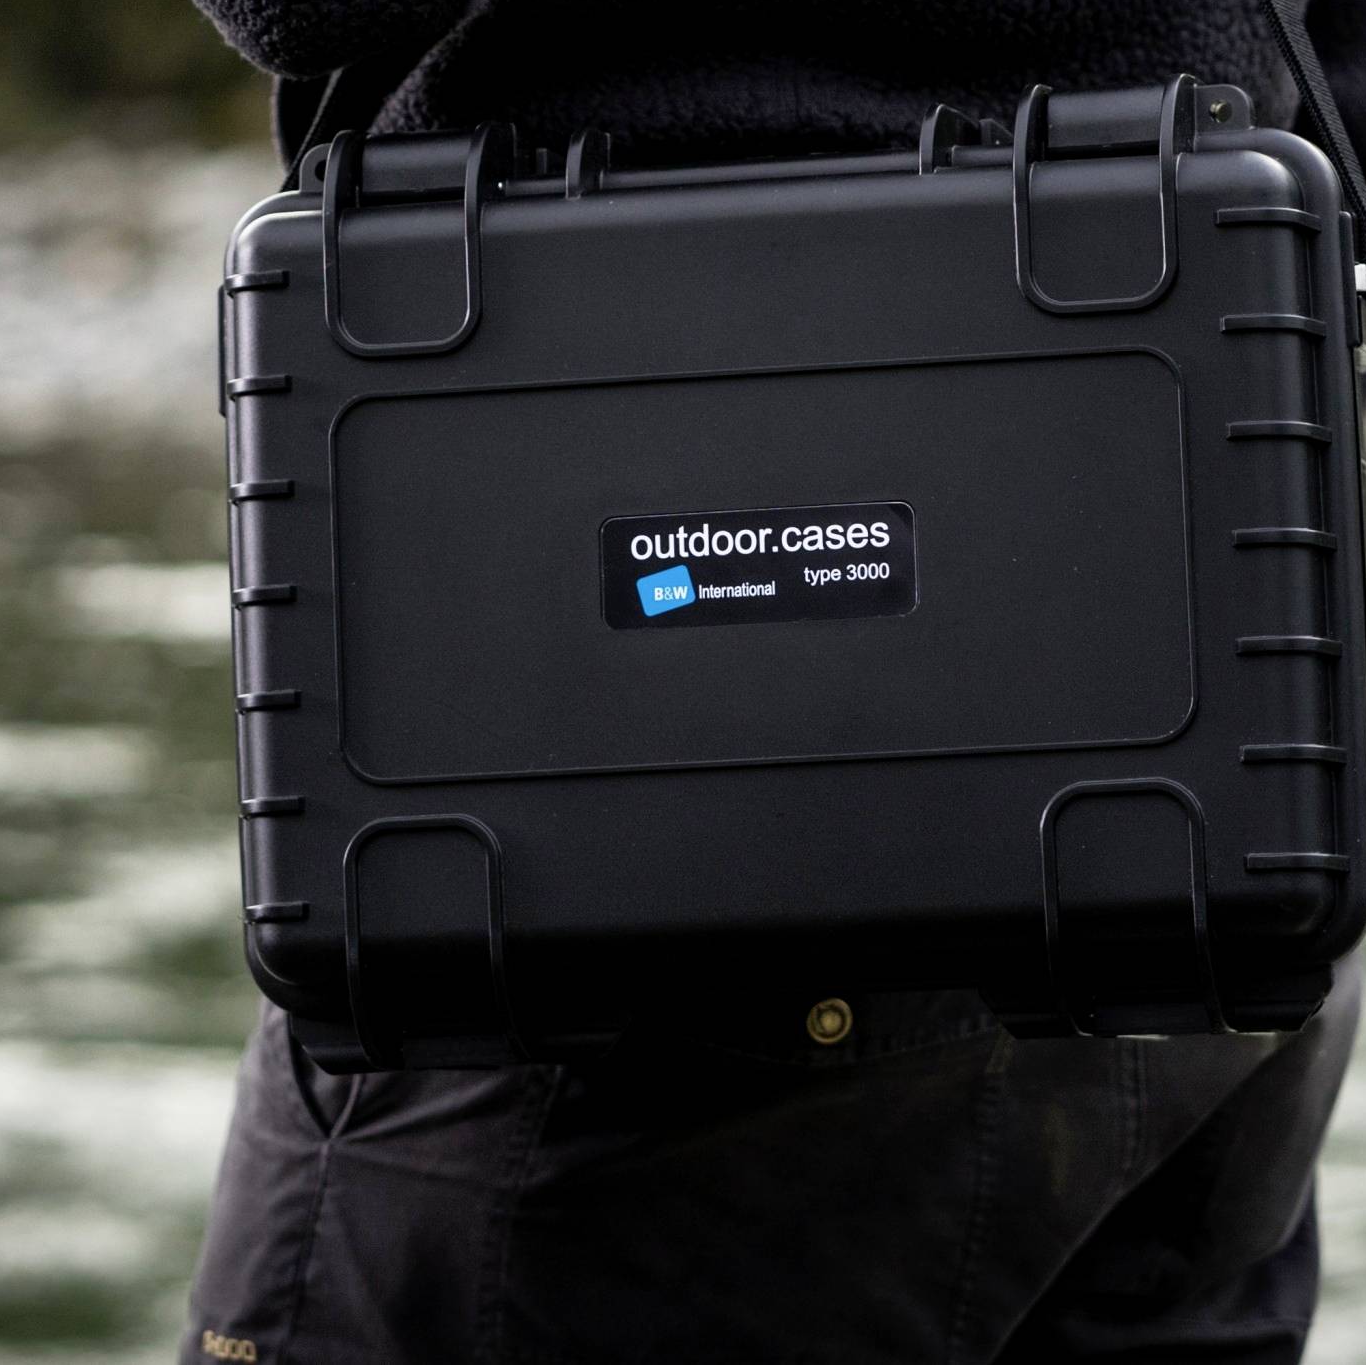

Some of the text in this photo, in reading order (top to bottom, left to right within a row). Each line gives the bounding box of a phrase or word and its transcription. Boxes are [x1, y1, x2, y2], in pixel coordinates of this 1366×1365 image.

[631, 521, 891, 560] outdoor.cases
[803, 562, 890, 586] type 3000
[653, 580, 776, 602] B&W International
